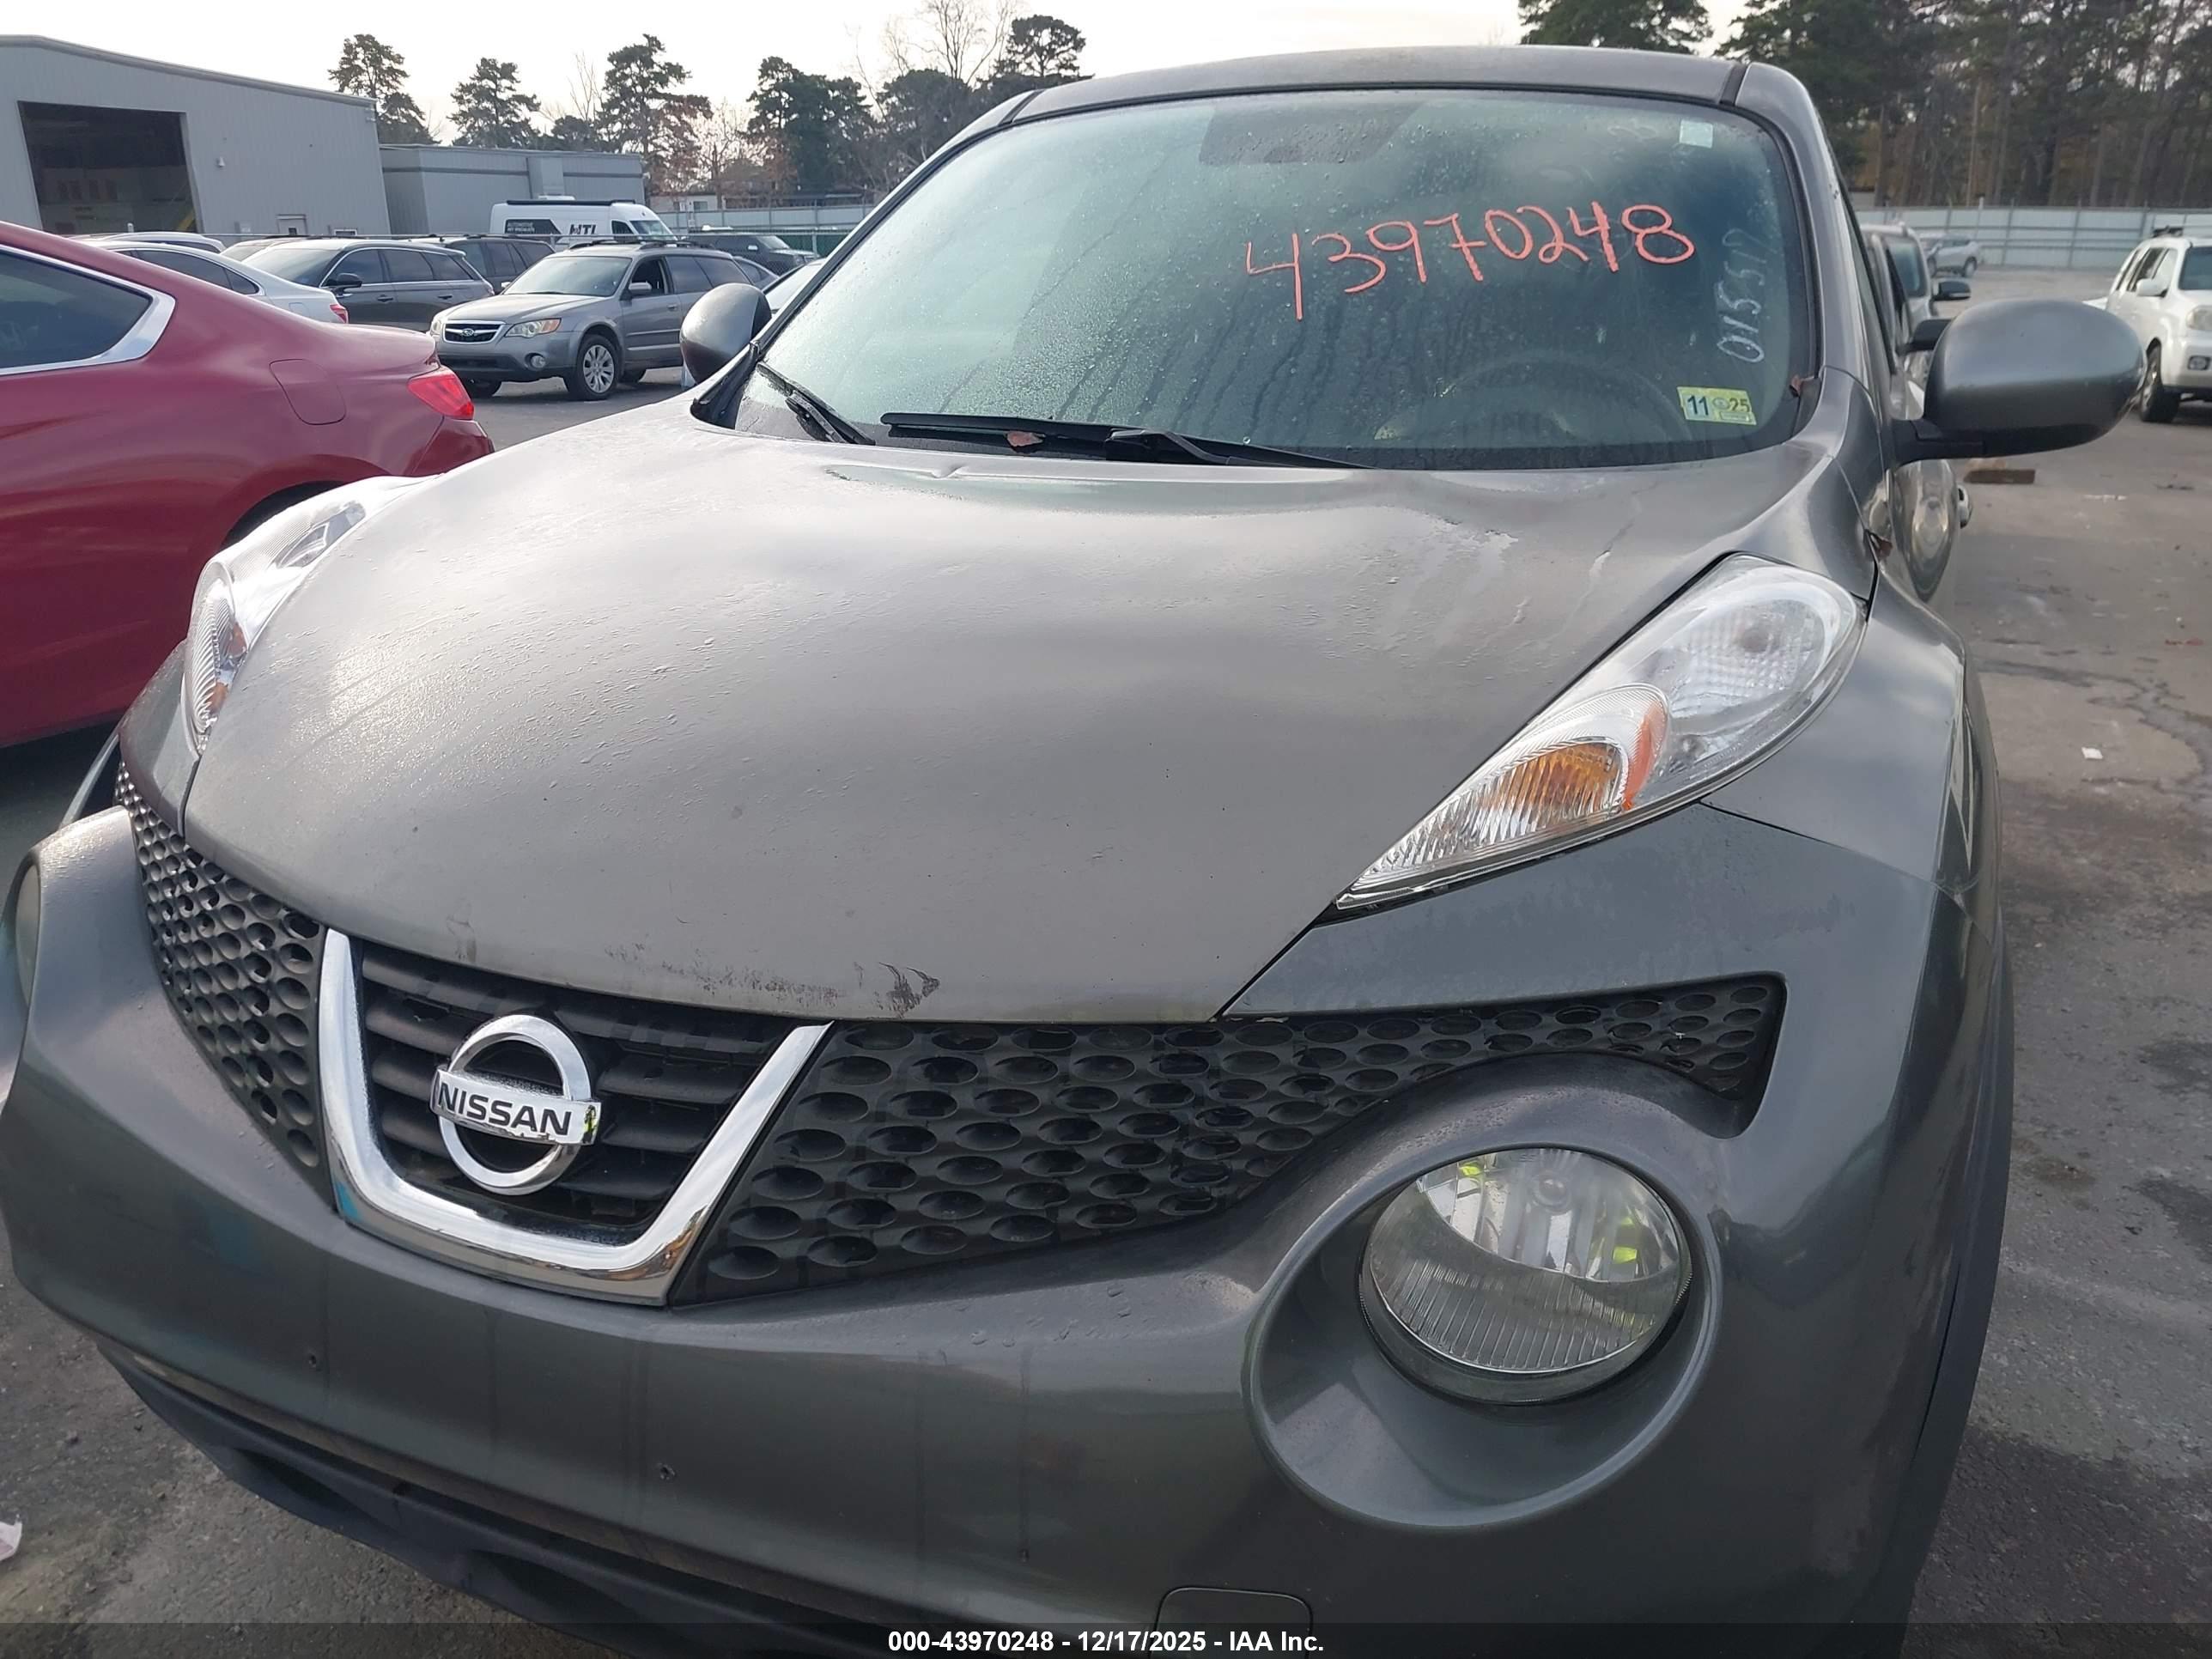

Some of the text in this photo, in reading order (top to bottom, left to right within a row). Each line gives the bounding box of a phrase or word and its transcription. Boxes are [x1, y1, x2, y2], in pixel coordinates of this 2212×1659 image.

[1245, 201, 1695, 321] 43970248
[1687, 395, 1750, 416] 11 25
[437, 1082, 572, 1136] NISSAN
